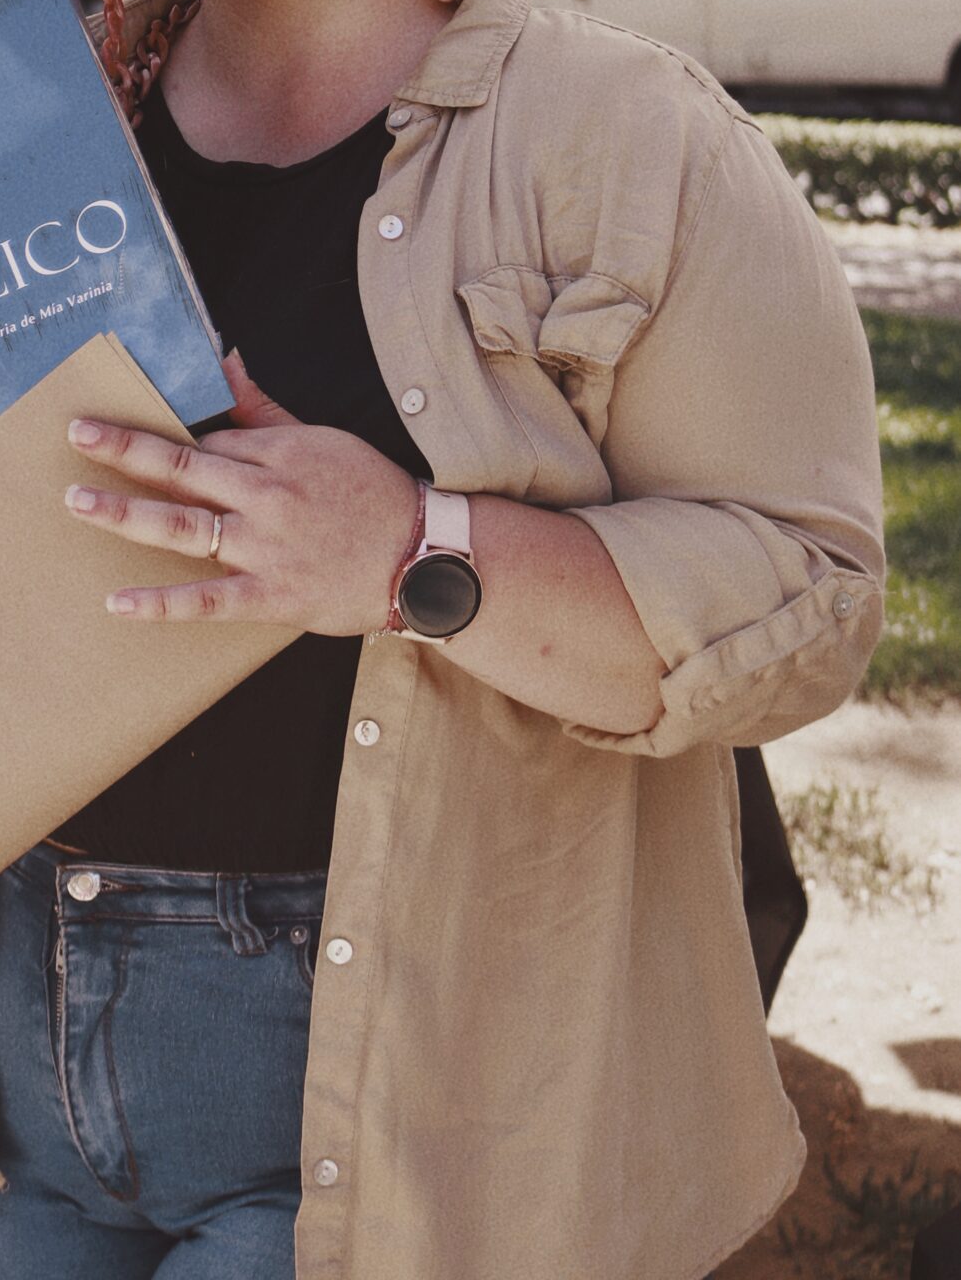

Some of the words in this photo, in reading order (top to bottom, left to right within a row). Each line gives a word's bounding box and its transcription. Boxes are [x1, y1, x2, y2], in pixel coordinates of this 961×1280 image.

[20, 311, 36, 328] de
[40, 303, 64, 320] Mía
[66, 281, 113, 307] Varinia
